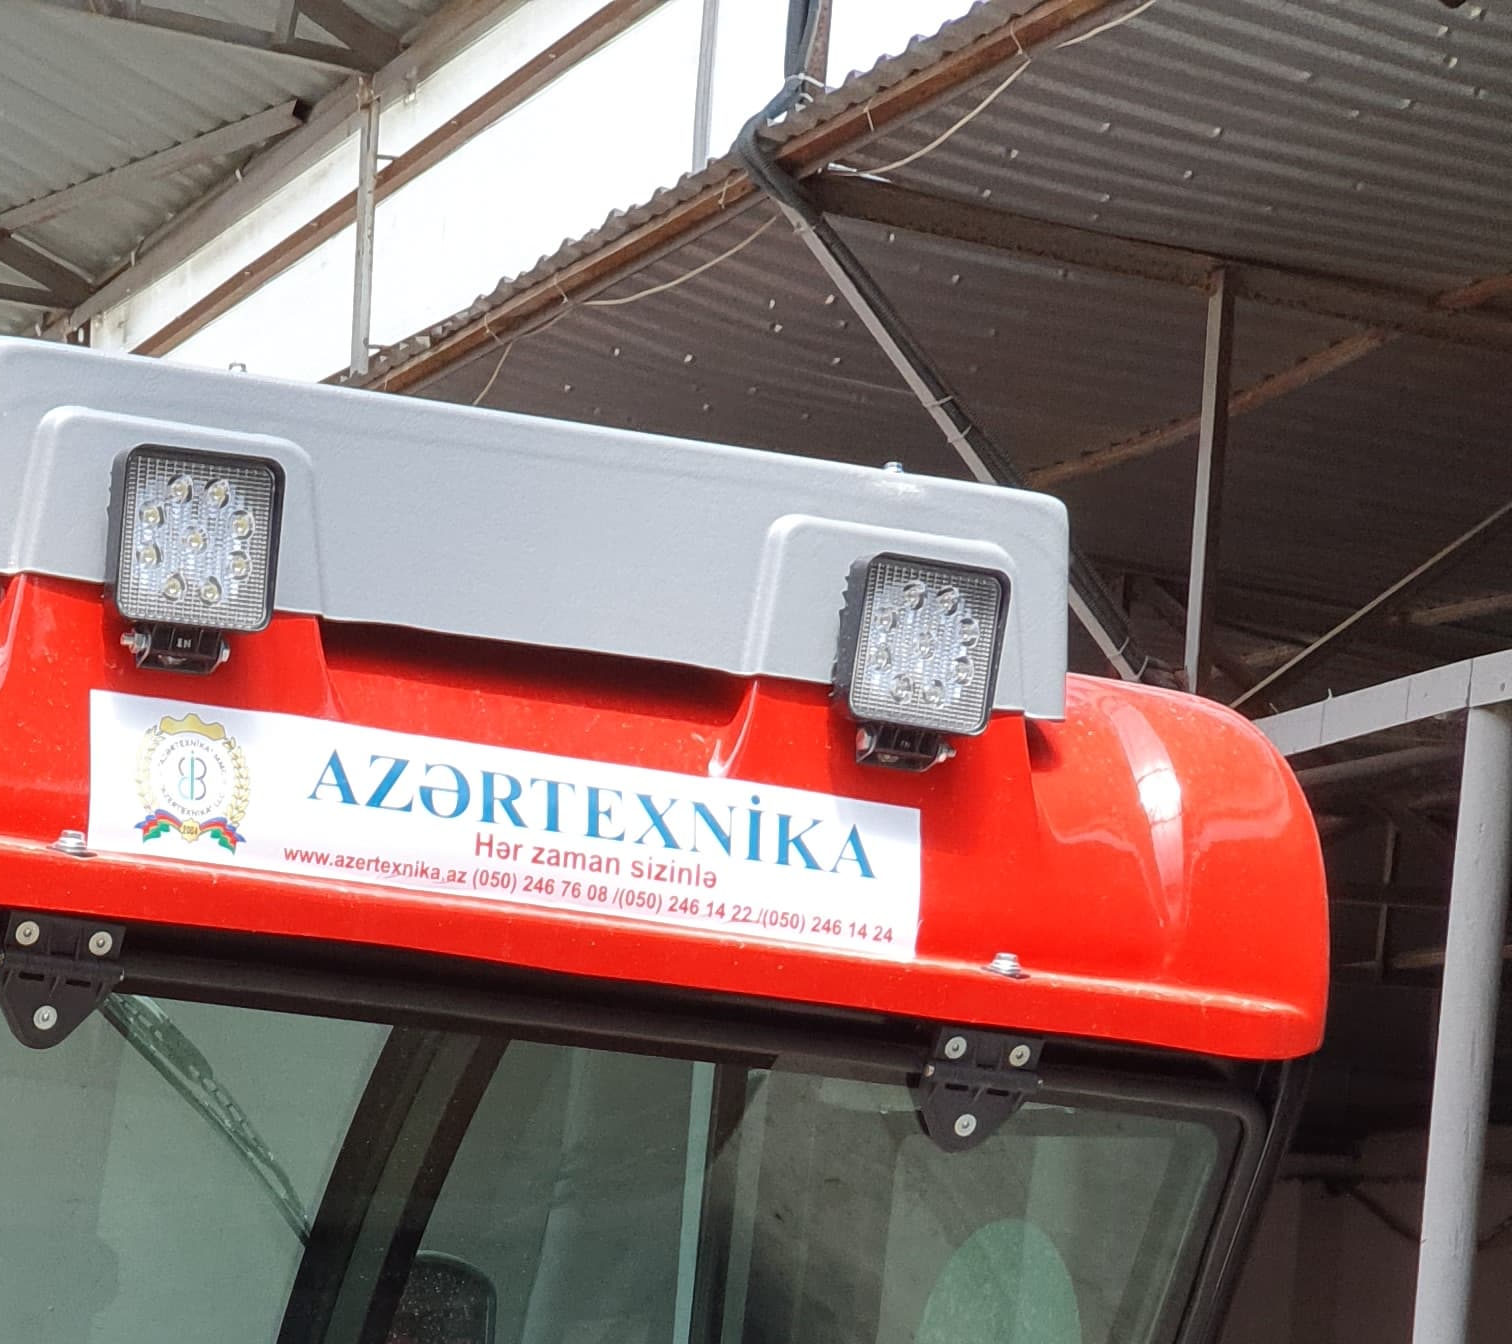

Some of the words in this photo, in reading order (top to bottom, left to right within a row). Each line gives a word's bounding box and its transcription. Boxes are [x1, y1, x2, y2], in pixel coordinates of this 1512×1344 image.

[307, 749, 876, 878] AZƏRTEXNİKA
[474, 831, 523, 862] Hər
[530, 845, 620, 875] zaman
[630, 855, 717, 889] sizinlə
[283, 847, 467, 884] www.azertexnika.az
[473, 868, 518, 893] (050)
[523, 875, 555, 895] 246
[561, 880, 582, 901] 76
[587, 884, 608, 902] 08
[668, 895, 700, 915] 246
[706, 901, 726, 919] 14
[731, 904, 752, 923] 22
[811, 916, 843, 936] 246
[848, 921, 868, 939] 14
[872, 926, 894, 943] 24
